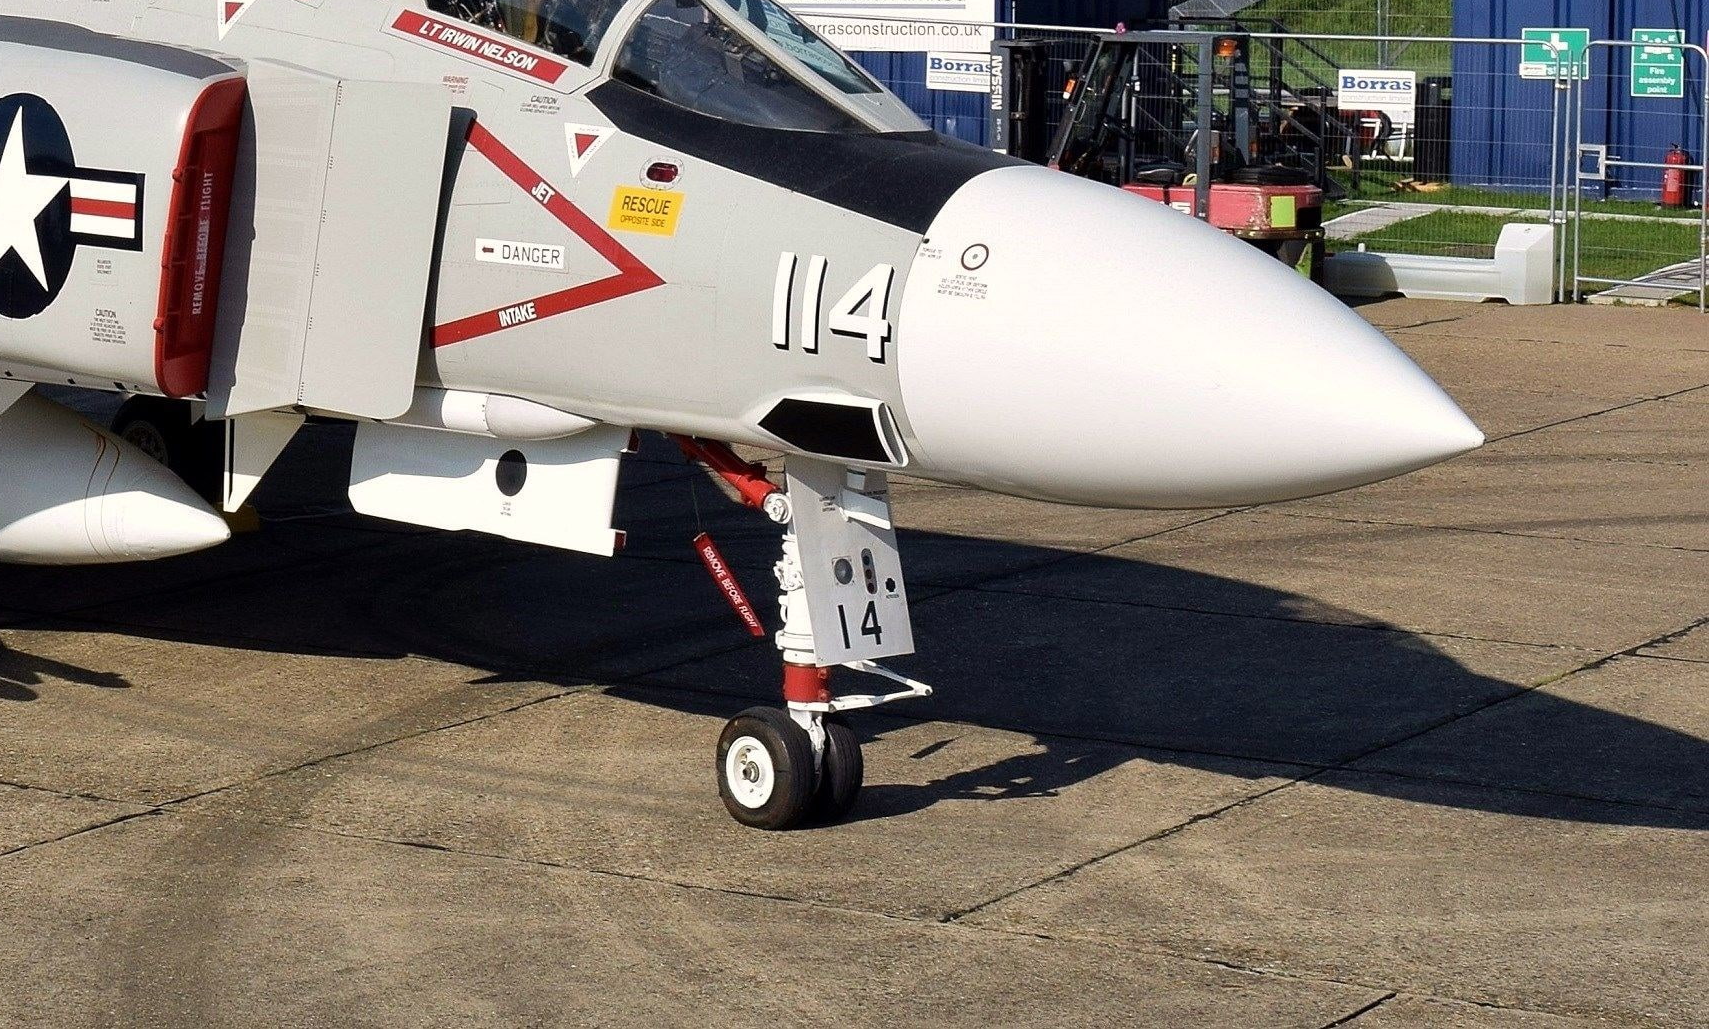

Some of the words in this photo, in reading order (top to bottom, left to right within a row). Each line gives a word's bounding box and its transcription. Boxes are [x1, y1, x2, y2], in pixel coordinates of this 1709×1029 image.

[418, 19, 442, 36] LT
[439, 27, 482, 51] IRWIN
[479, 40, 539, 72] NELSON
[929, 58, 992, 73] Borras
[991, 55, 1003, 110] NISSAN
[1342, 76, 1412, 91] Borras
[1638, 77, 1676, 86] assembly
[530, 95, 558, 105] CAUTION
[531, 181, 556, 205] JET
[621, 195, 672, 216] RESCUE
[620, 214, 650, 226] OPPOSITE
[651, 218, 666, 228] SIDE
[192, 269, 206, 316] REMOVE
[200, 172, 214, 211] FLIGHT
[502, 244, 561, 265] DANGER
[497, 302, 538, 328] INTAKE
[771, 251, 895, 365] 114
[702, 545, 727, 579] REMOVE
[721, 578, 744, 605] BEFORE
[738, 605, 758, 628] FLIGHT
[837, 600, 883, 650] 14
